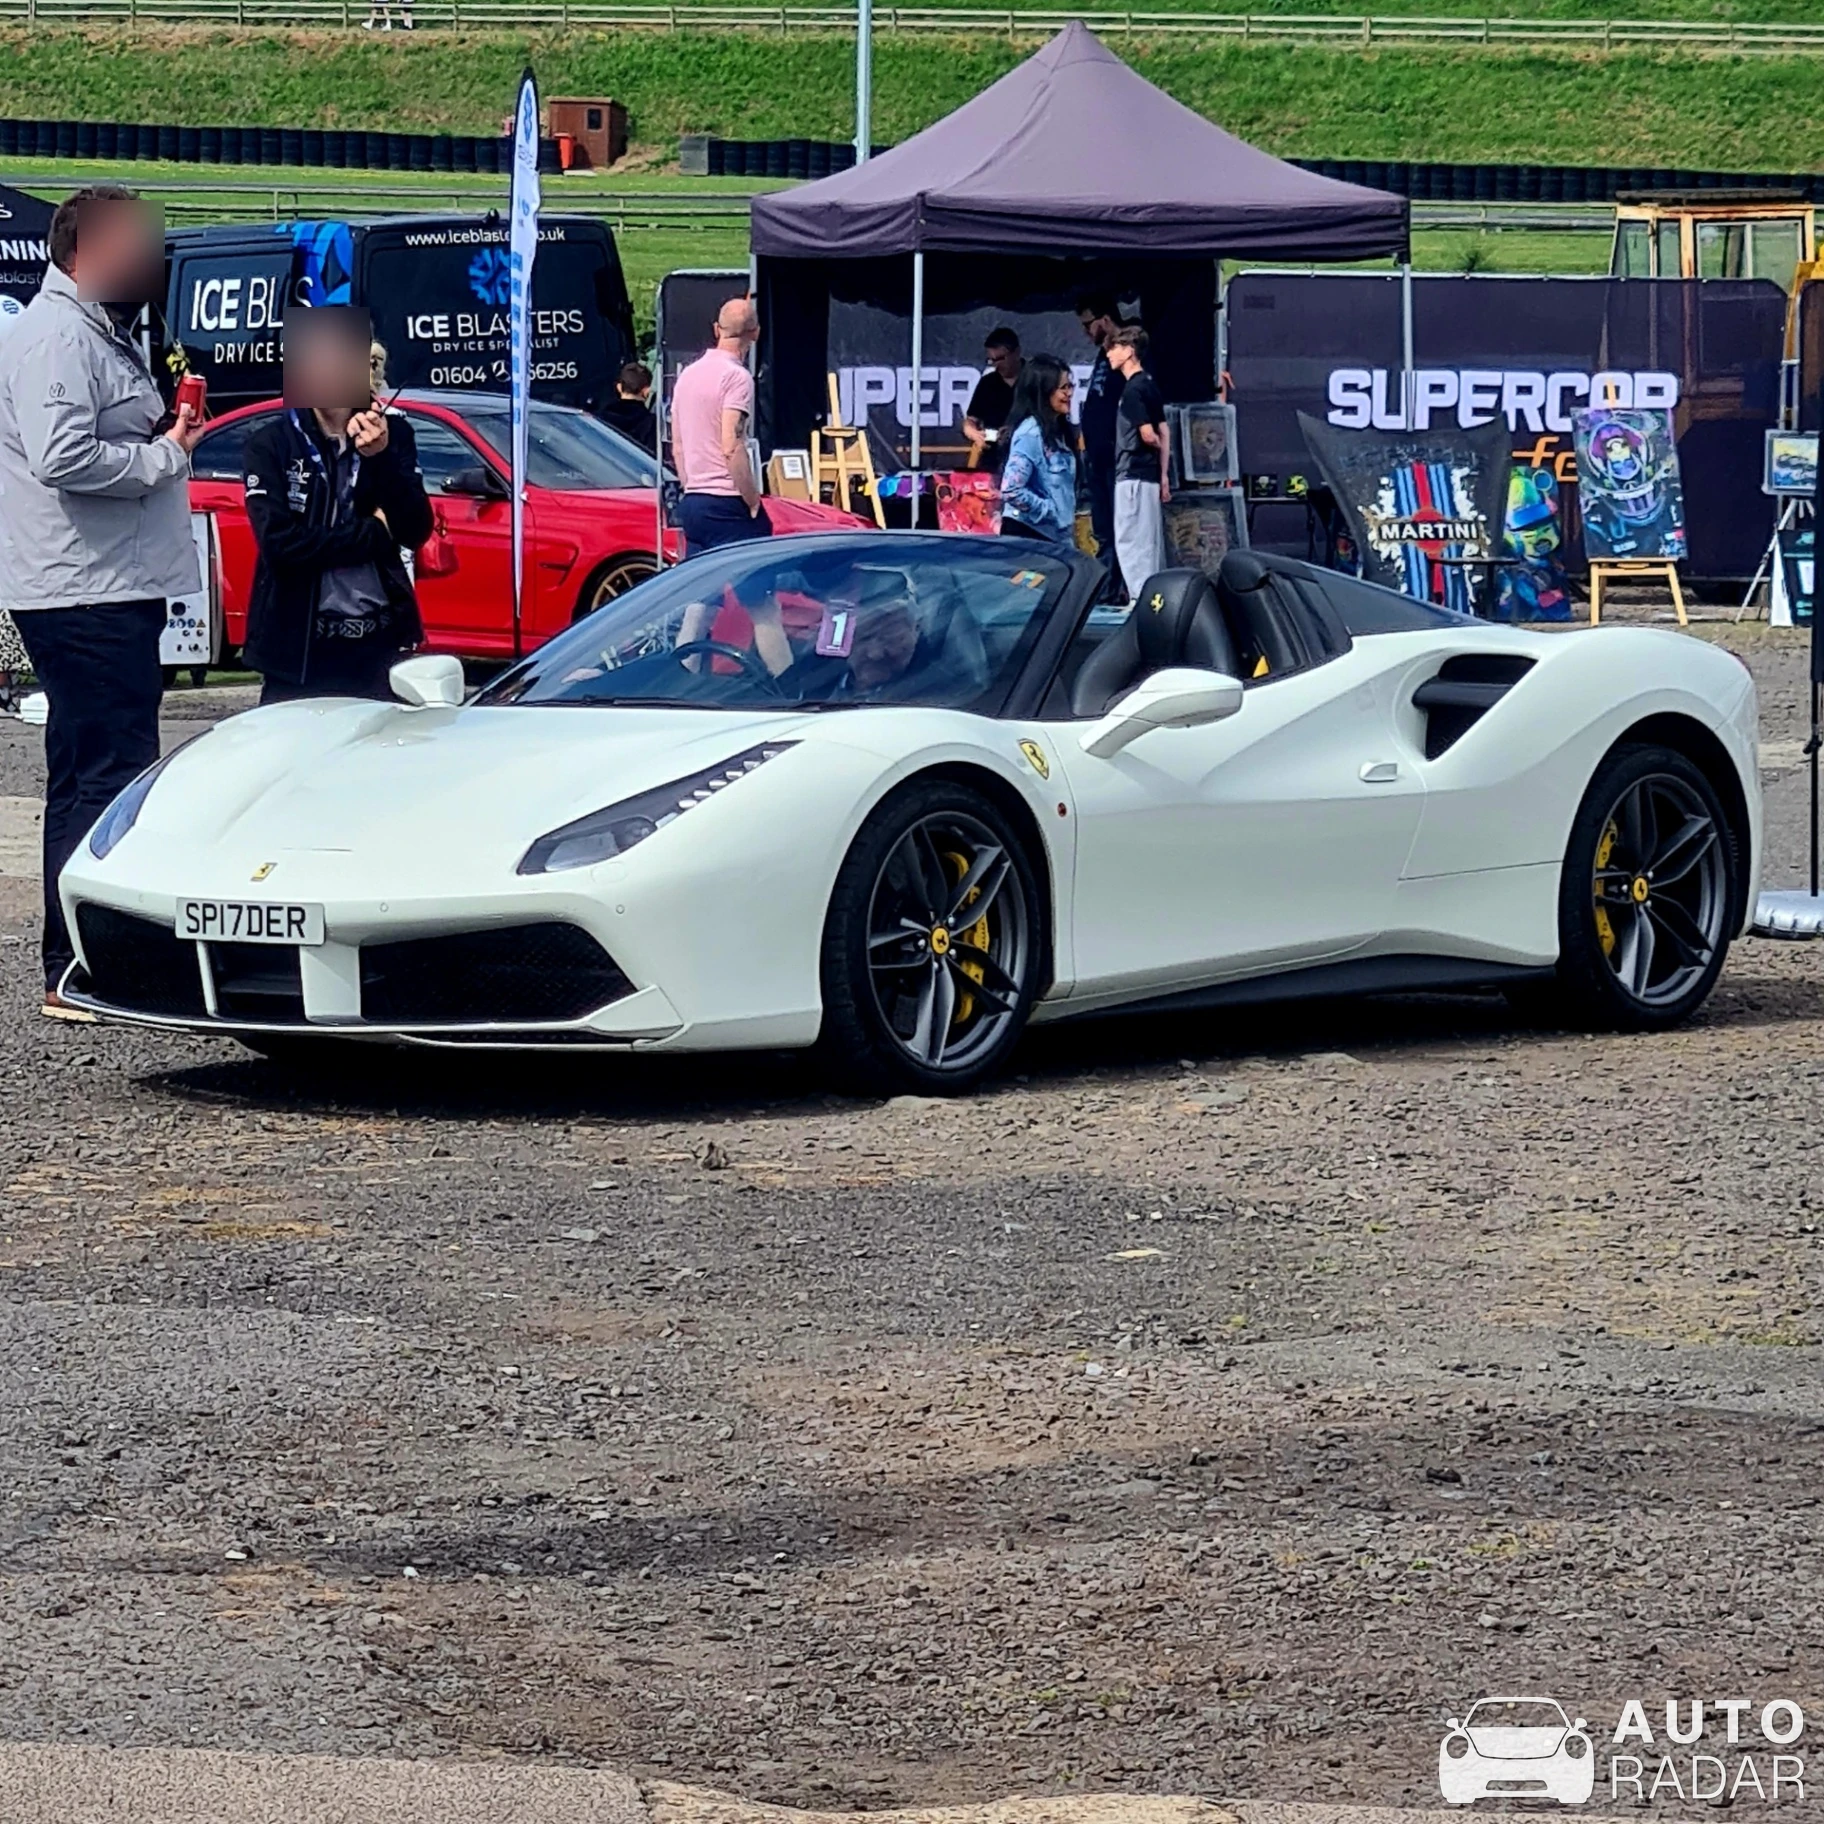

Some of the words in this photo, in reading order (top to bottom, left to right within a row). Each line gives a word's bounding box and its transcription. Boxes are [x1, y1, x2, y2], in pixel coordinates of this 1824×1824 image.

[0, 240, 51, 261] NIN
[191, 279, 242, 331] ICE
[407, 315, 450, 340] ICE
[457, 309, 584, 338] BLAERS
[215, 342, 246, 363] DRY
[249, 342, 275, 362] ICE
[433, 342, 460, 353] DRY
[464, 341, 485, 351] ICE
[489, 337, 560, 351] SPELIST
[430, 366, 487, 385] 01604
[1380, 522, 1478, 540] MARTINI
[826, 611, 848, 650] 1
